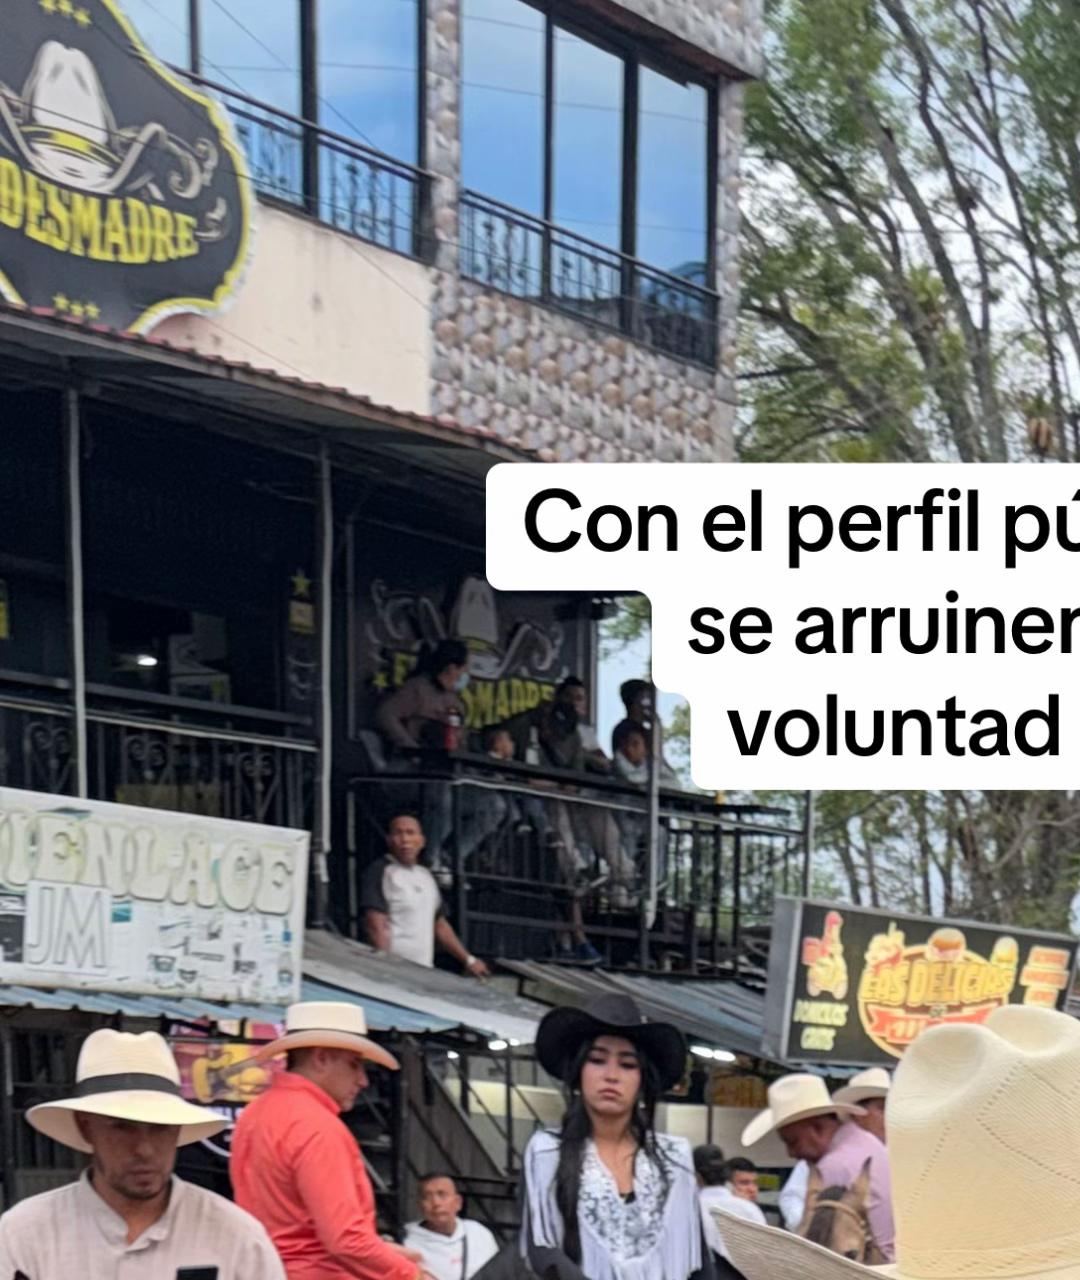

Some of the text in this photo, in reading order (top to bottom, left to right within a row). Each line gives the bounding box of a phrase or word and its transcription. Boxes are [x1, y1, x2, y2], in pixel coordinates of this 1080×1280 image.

[0, 156, 199, 264] DESMADRE
[26, 885, 108, 971] JM
[861, 959, 1015, 1006] LAS DELICIAS
